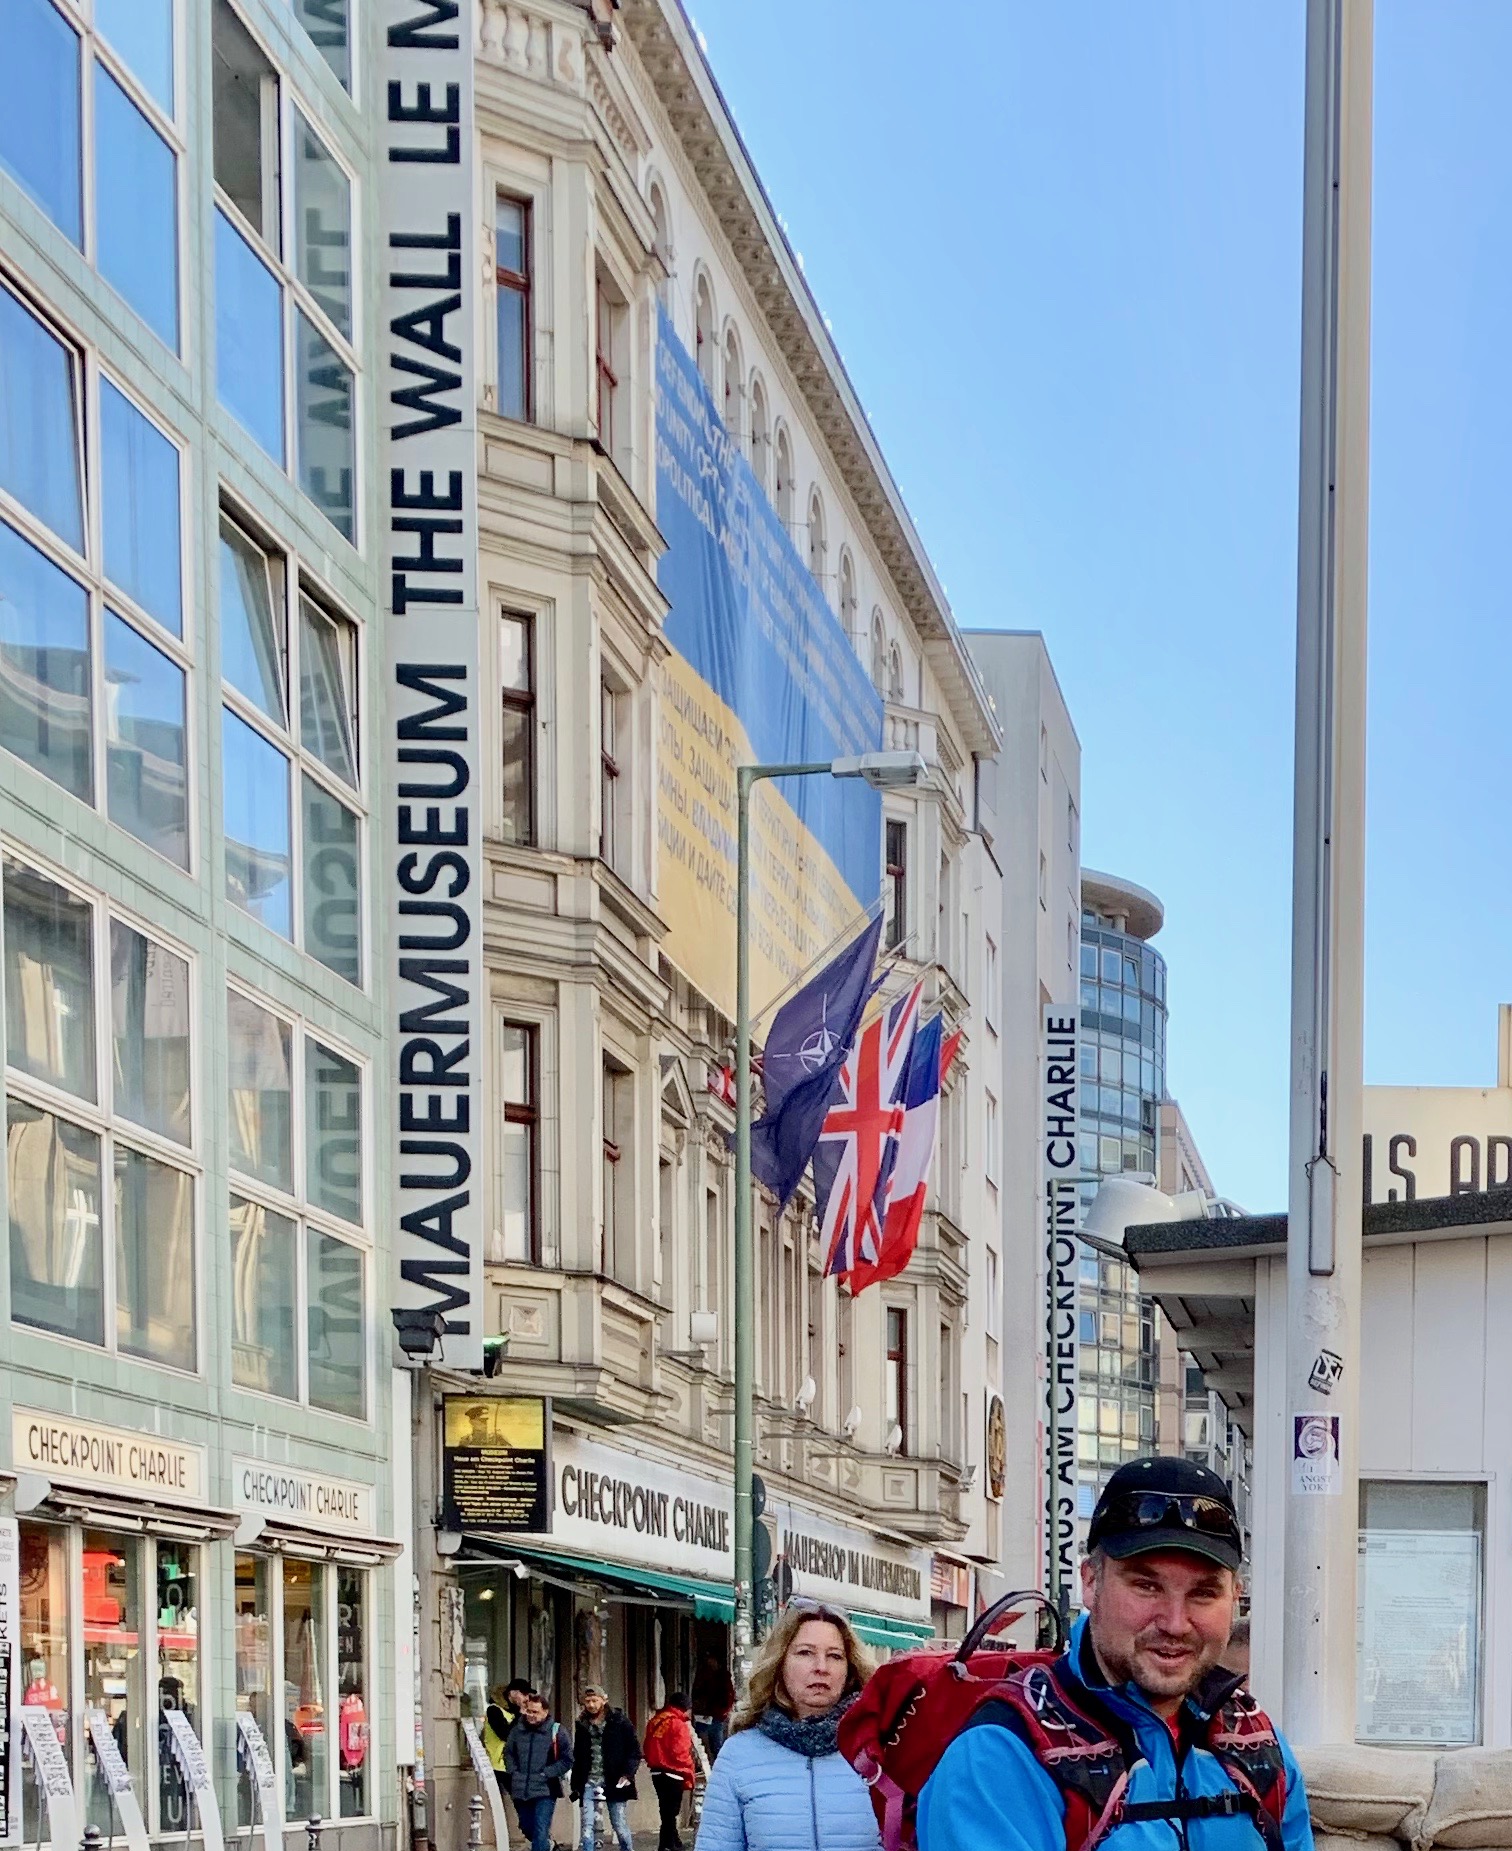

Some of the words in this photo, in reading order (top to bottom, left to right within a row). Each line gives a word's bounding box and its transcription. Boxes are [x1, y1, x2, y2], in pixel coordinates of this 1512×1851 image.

[387, 79, 461, 164] LE
[389, 211, 463, 442] WALL
[391, 468, 463, 615] THE
[395, 663, 471, 1336] MAUERMUSEUM
[1046, 1015, 1077, 1169] CHARLIE
[29, 1424, 124, 1476] CHECKPOINT
[130, 1446, 186, 1489] CHARLIE
[243, 1470, 312, 1511] CHECKPOINT
[317, 1485, 359, 1521] CHARLIE
[1045, 1423, 1076, 1486] AM
[562, 1464, 669, 1538] CHECKPOINT
[673, 1496, 730, 1553] CHARLIE
[784, 1529, 846, 1583] MAUERSHOP
